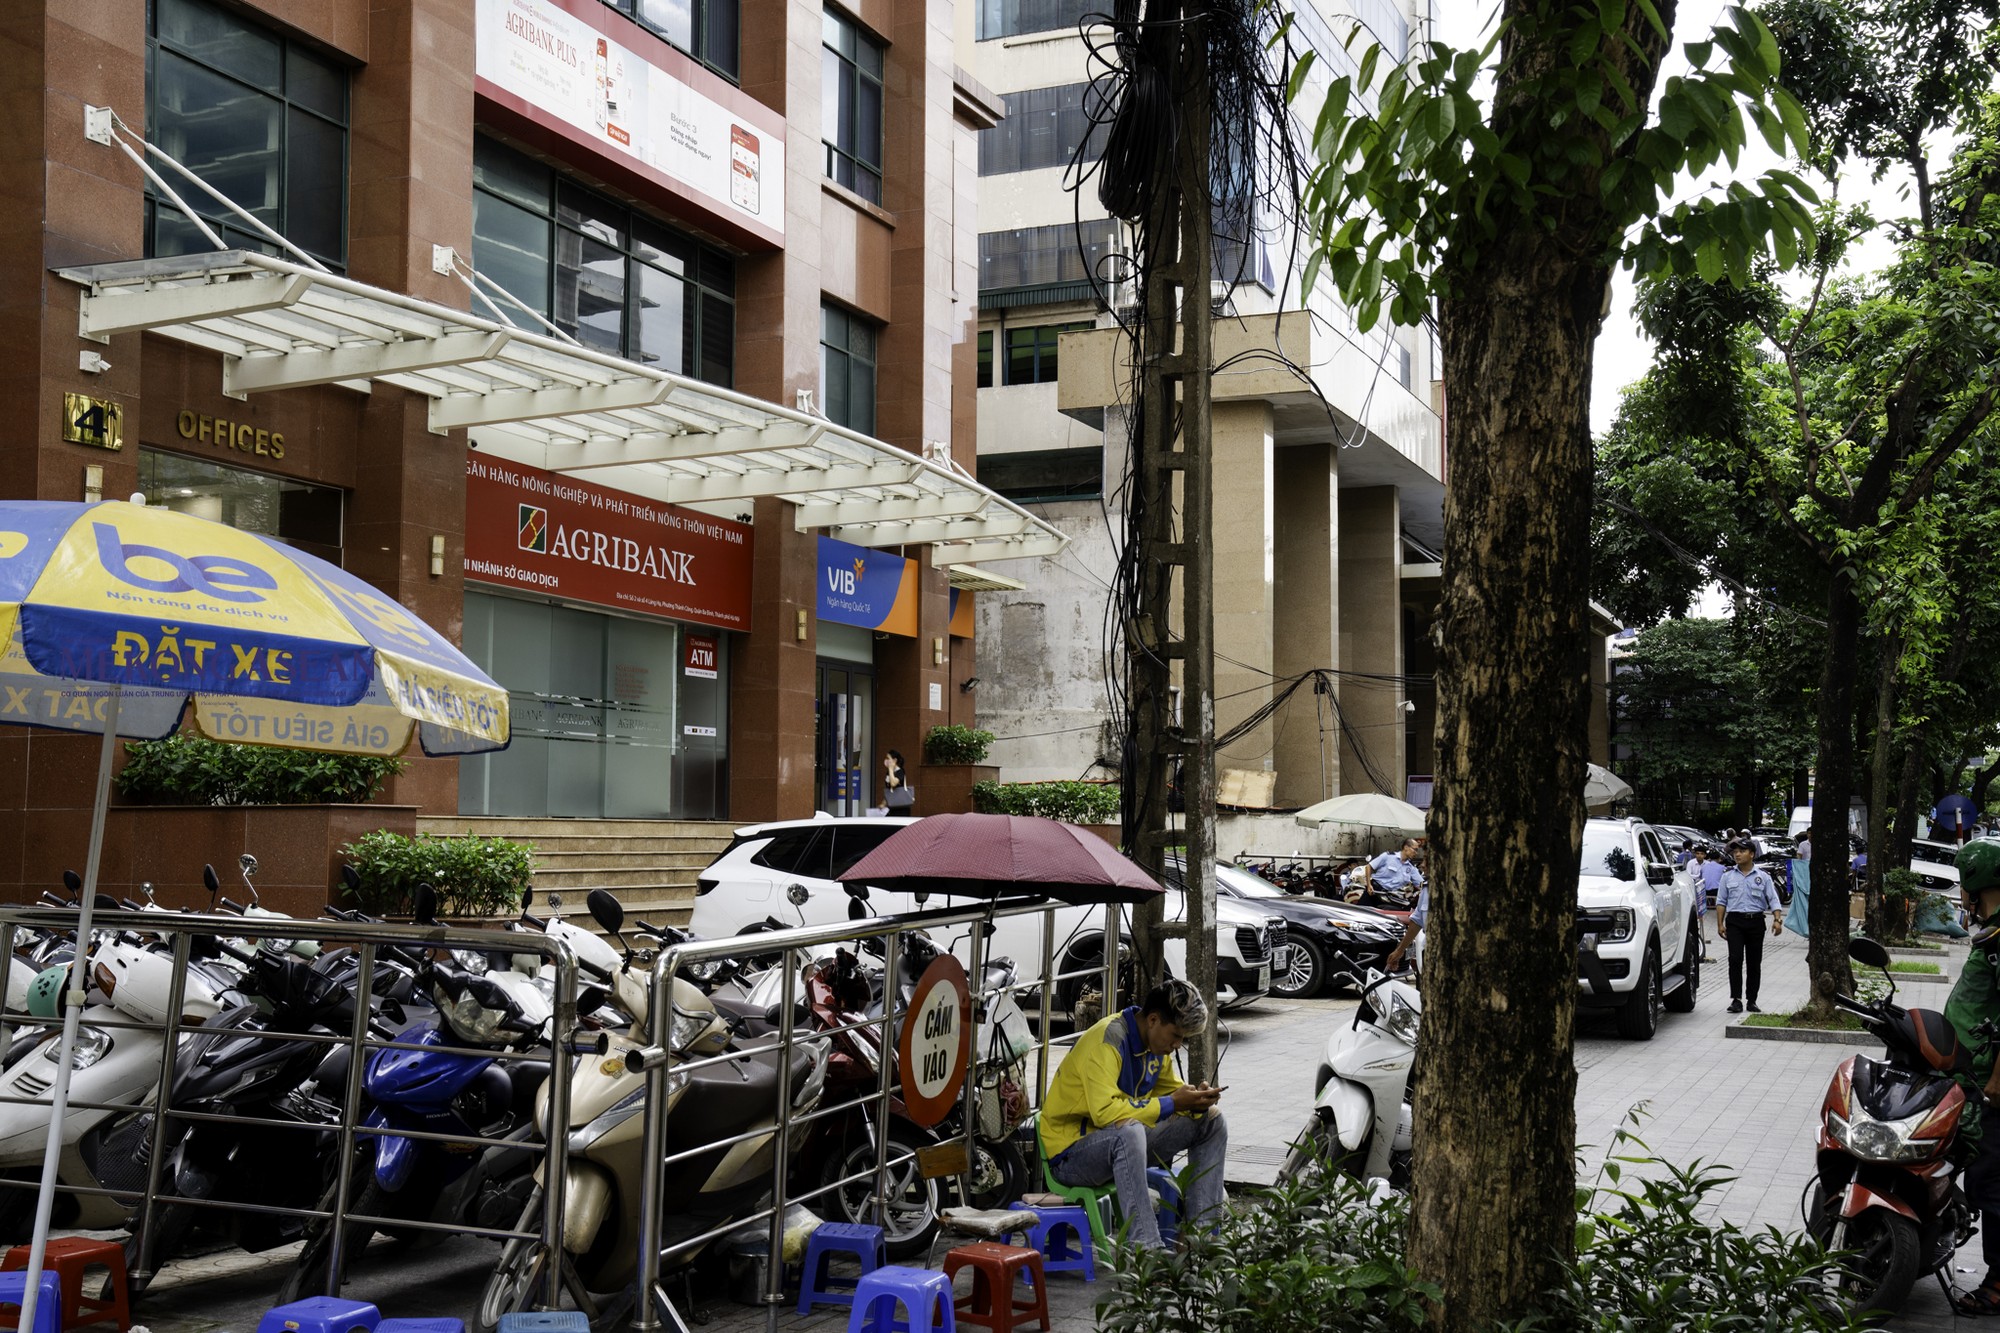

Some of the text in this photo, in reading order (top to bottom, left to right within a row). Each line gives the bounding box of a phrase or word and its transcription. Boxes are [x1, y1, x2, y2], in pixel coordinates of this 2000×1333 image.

[505, 10, 554, 55] AGRIBANK
[557, 38, 577, 68] PLUS
[692, 124, 697, 134] 3
[178, 409, 285, 460] OFFICES
[490, 466, 519, 487] HÀNG
[522, 475, 551, 495] NÔNG
[553, 484, 588, 506] NGHIỆP
[591, 493, 603, 509] VÀ
[605, 498, 628, 515] PHÁT
[631, 505, 655, 523] TRIỂN
[657, 511, 681, 529] NÔNG
[683, 518, 705, 535] THÔN
[707, 524, 723, 541] VIỆT
[725, 529, 743, 545] NAM
[92, 522, 278, 603] be
[471, 560, 502, 577] NHÁNH
[504, 564, 516, 579] SỞ
[517, 570, 537, 583] GIAO
[539, 574, 559, 588] DỊCH
[550, 524, 696, 586] AGRIBANK
[828, 566, 855, 596] VIB
[106, 590, 289, 623] Nền tảng đa dịch vụ
[827, 596, 839, 608] Ngân
[840, 598, 852, 612] hàng
[852, 601, 864, 612] Quốc
[111, 626, 292, 685] ĐẶT XE
[690, 649, 713, 667] ATM
[427, 684, 464, 721] SIÊU
[468, 693, 498, 734] TỐT
[924, 996, 954, 1040] CẤM
[923, 1044, 947, 1084] VÀO
